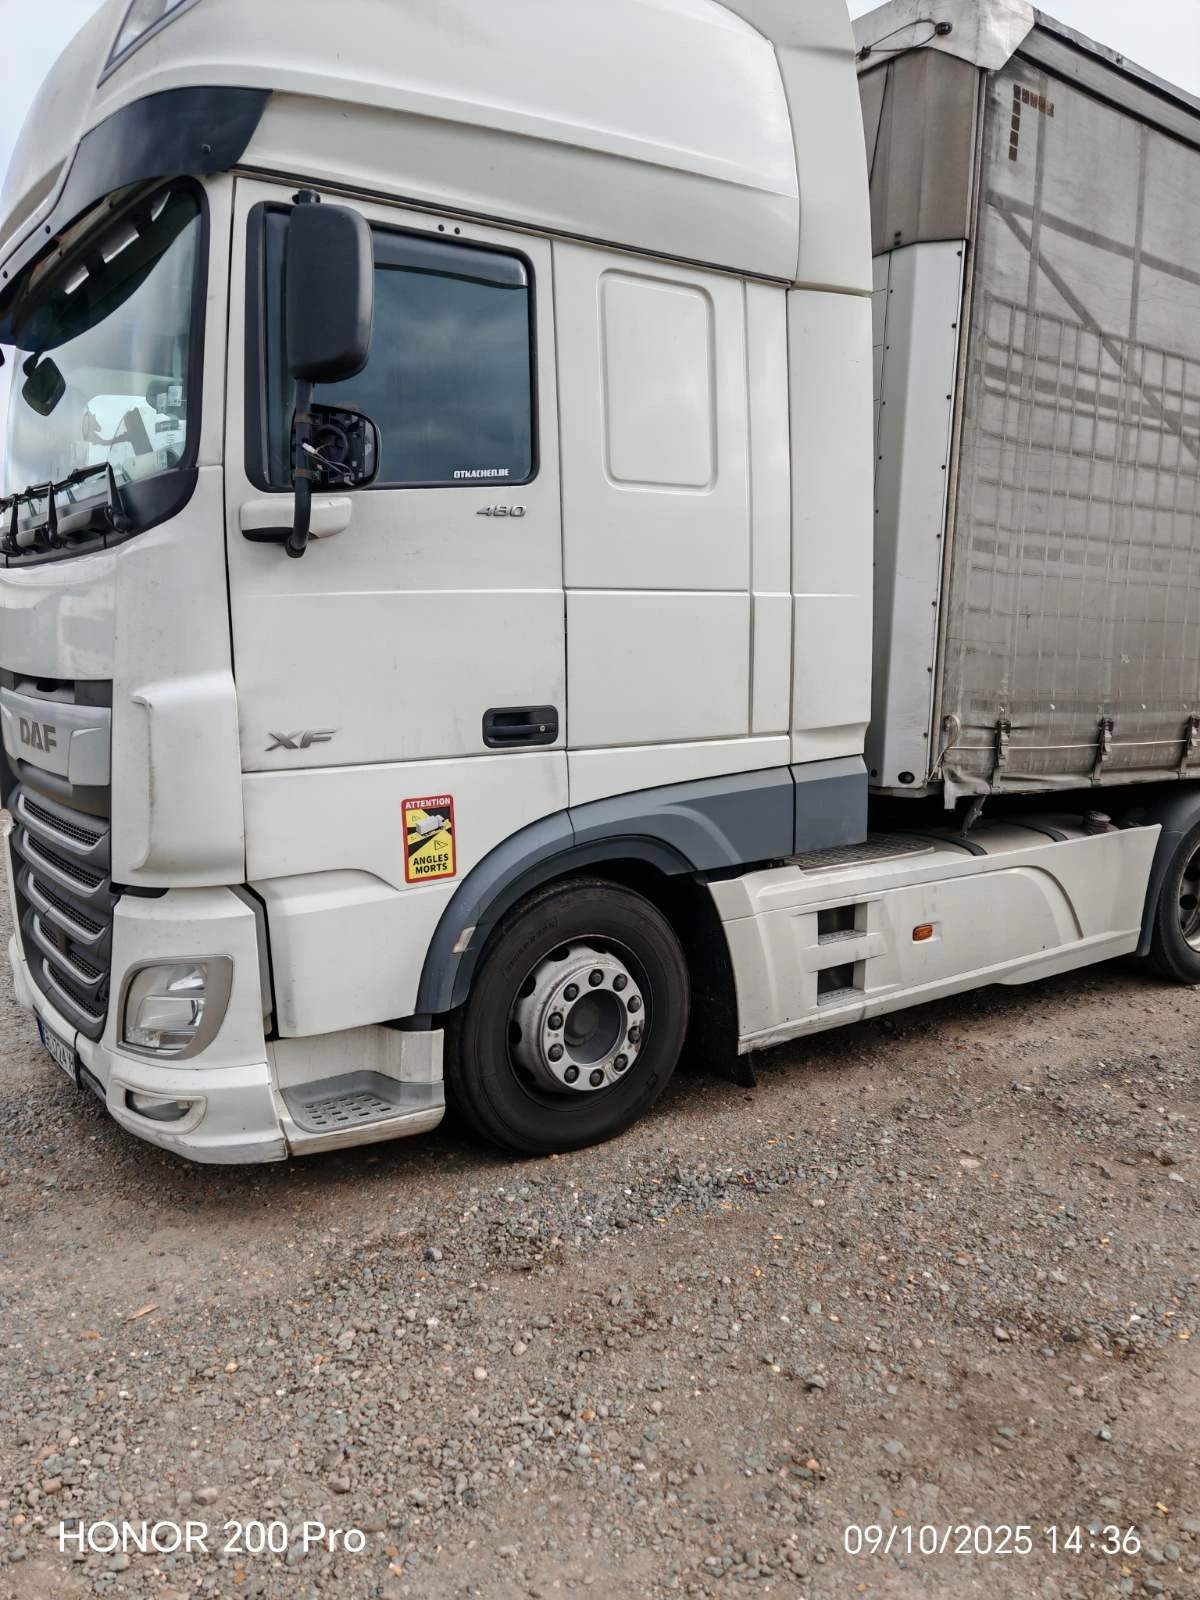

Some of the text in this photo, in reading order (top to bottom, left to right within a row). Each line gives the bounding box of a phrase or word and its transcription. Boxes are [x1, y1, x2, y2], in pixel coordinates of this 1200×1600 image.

[19, 716, 57, 753] DAF
[263, 728, 336, 752] XF
[405, 797, 451, 809] ATTENTION
[412, 853, 449, 866] ANGLES
[415, 862, 448, 874] MORTS
